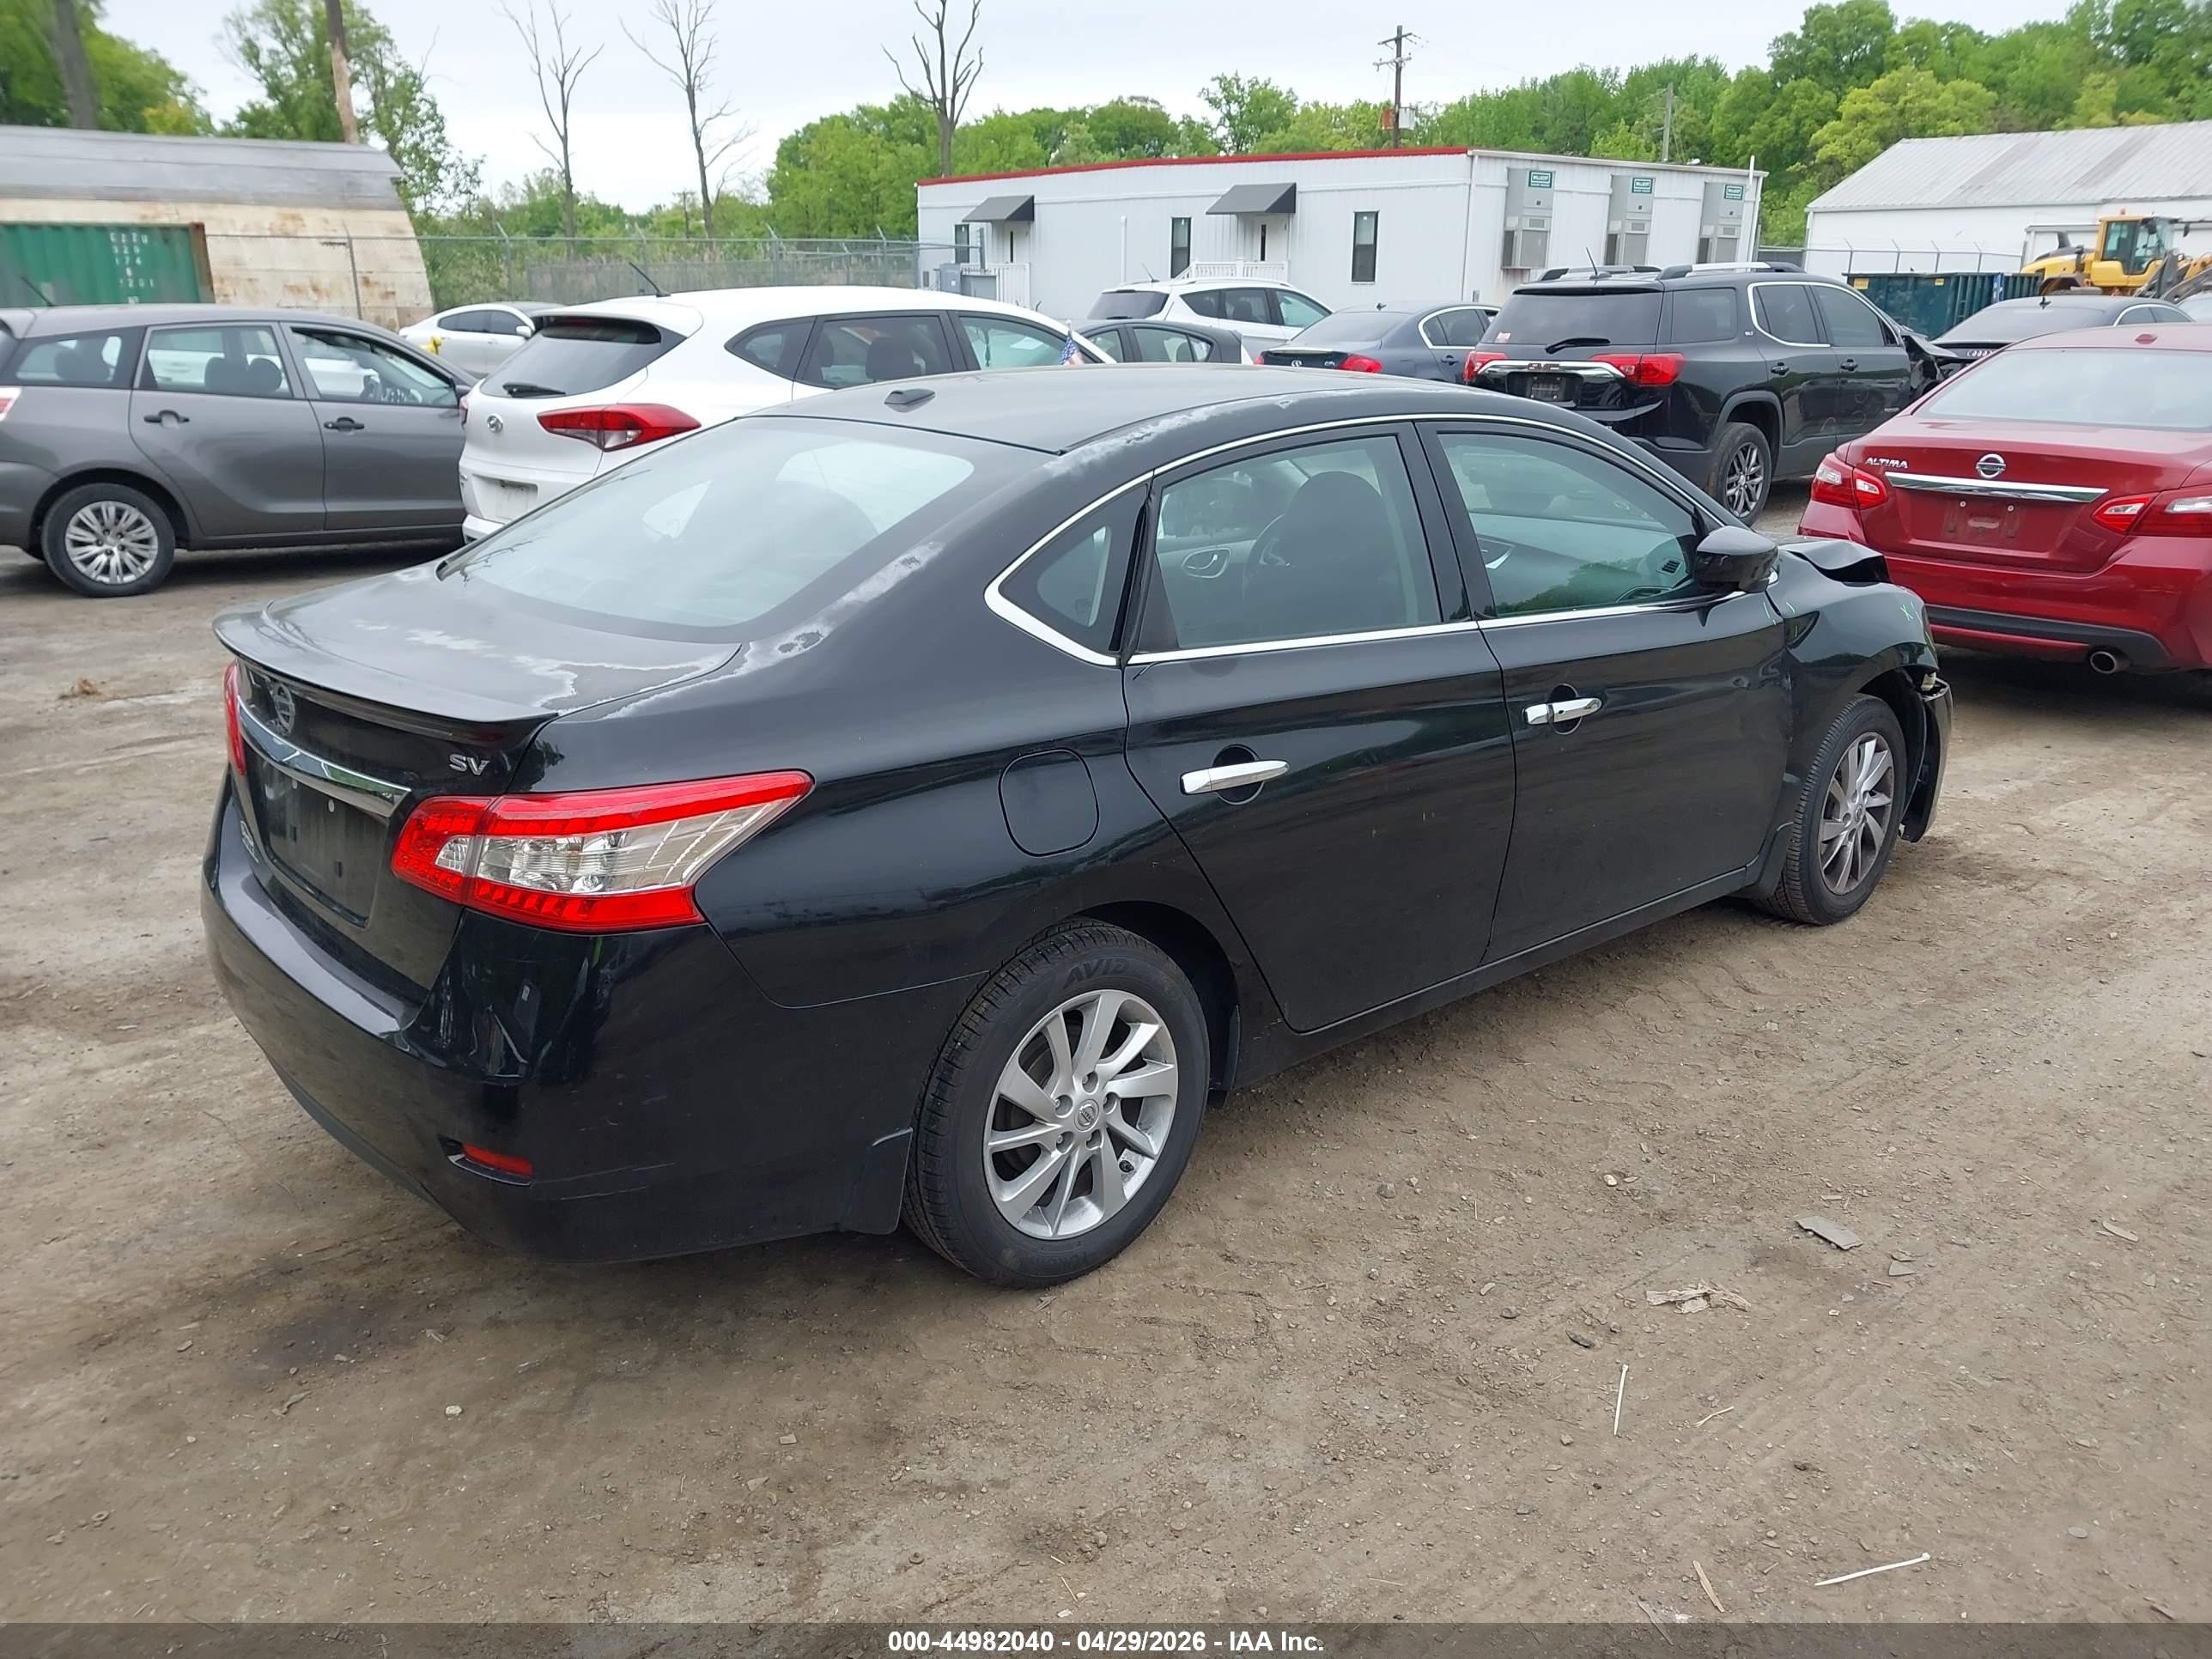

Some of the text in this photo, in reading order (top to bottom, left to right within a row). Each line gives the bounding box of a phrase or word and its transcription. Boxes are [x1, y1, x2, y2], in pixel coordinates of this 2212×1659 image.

[1528, 362, 1560, 371] GMC
[1865, 457, 1908, 469] ALTIMA
[449, 753, 490, 775] SV
